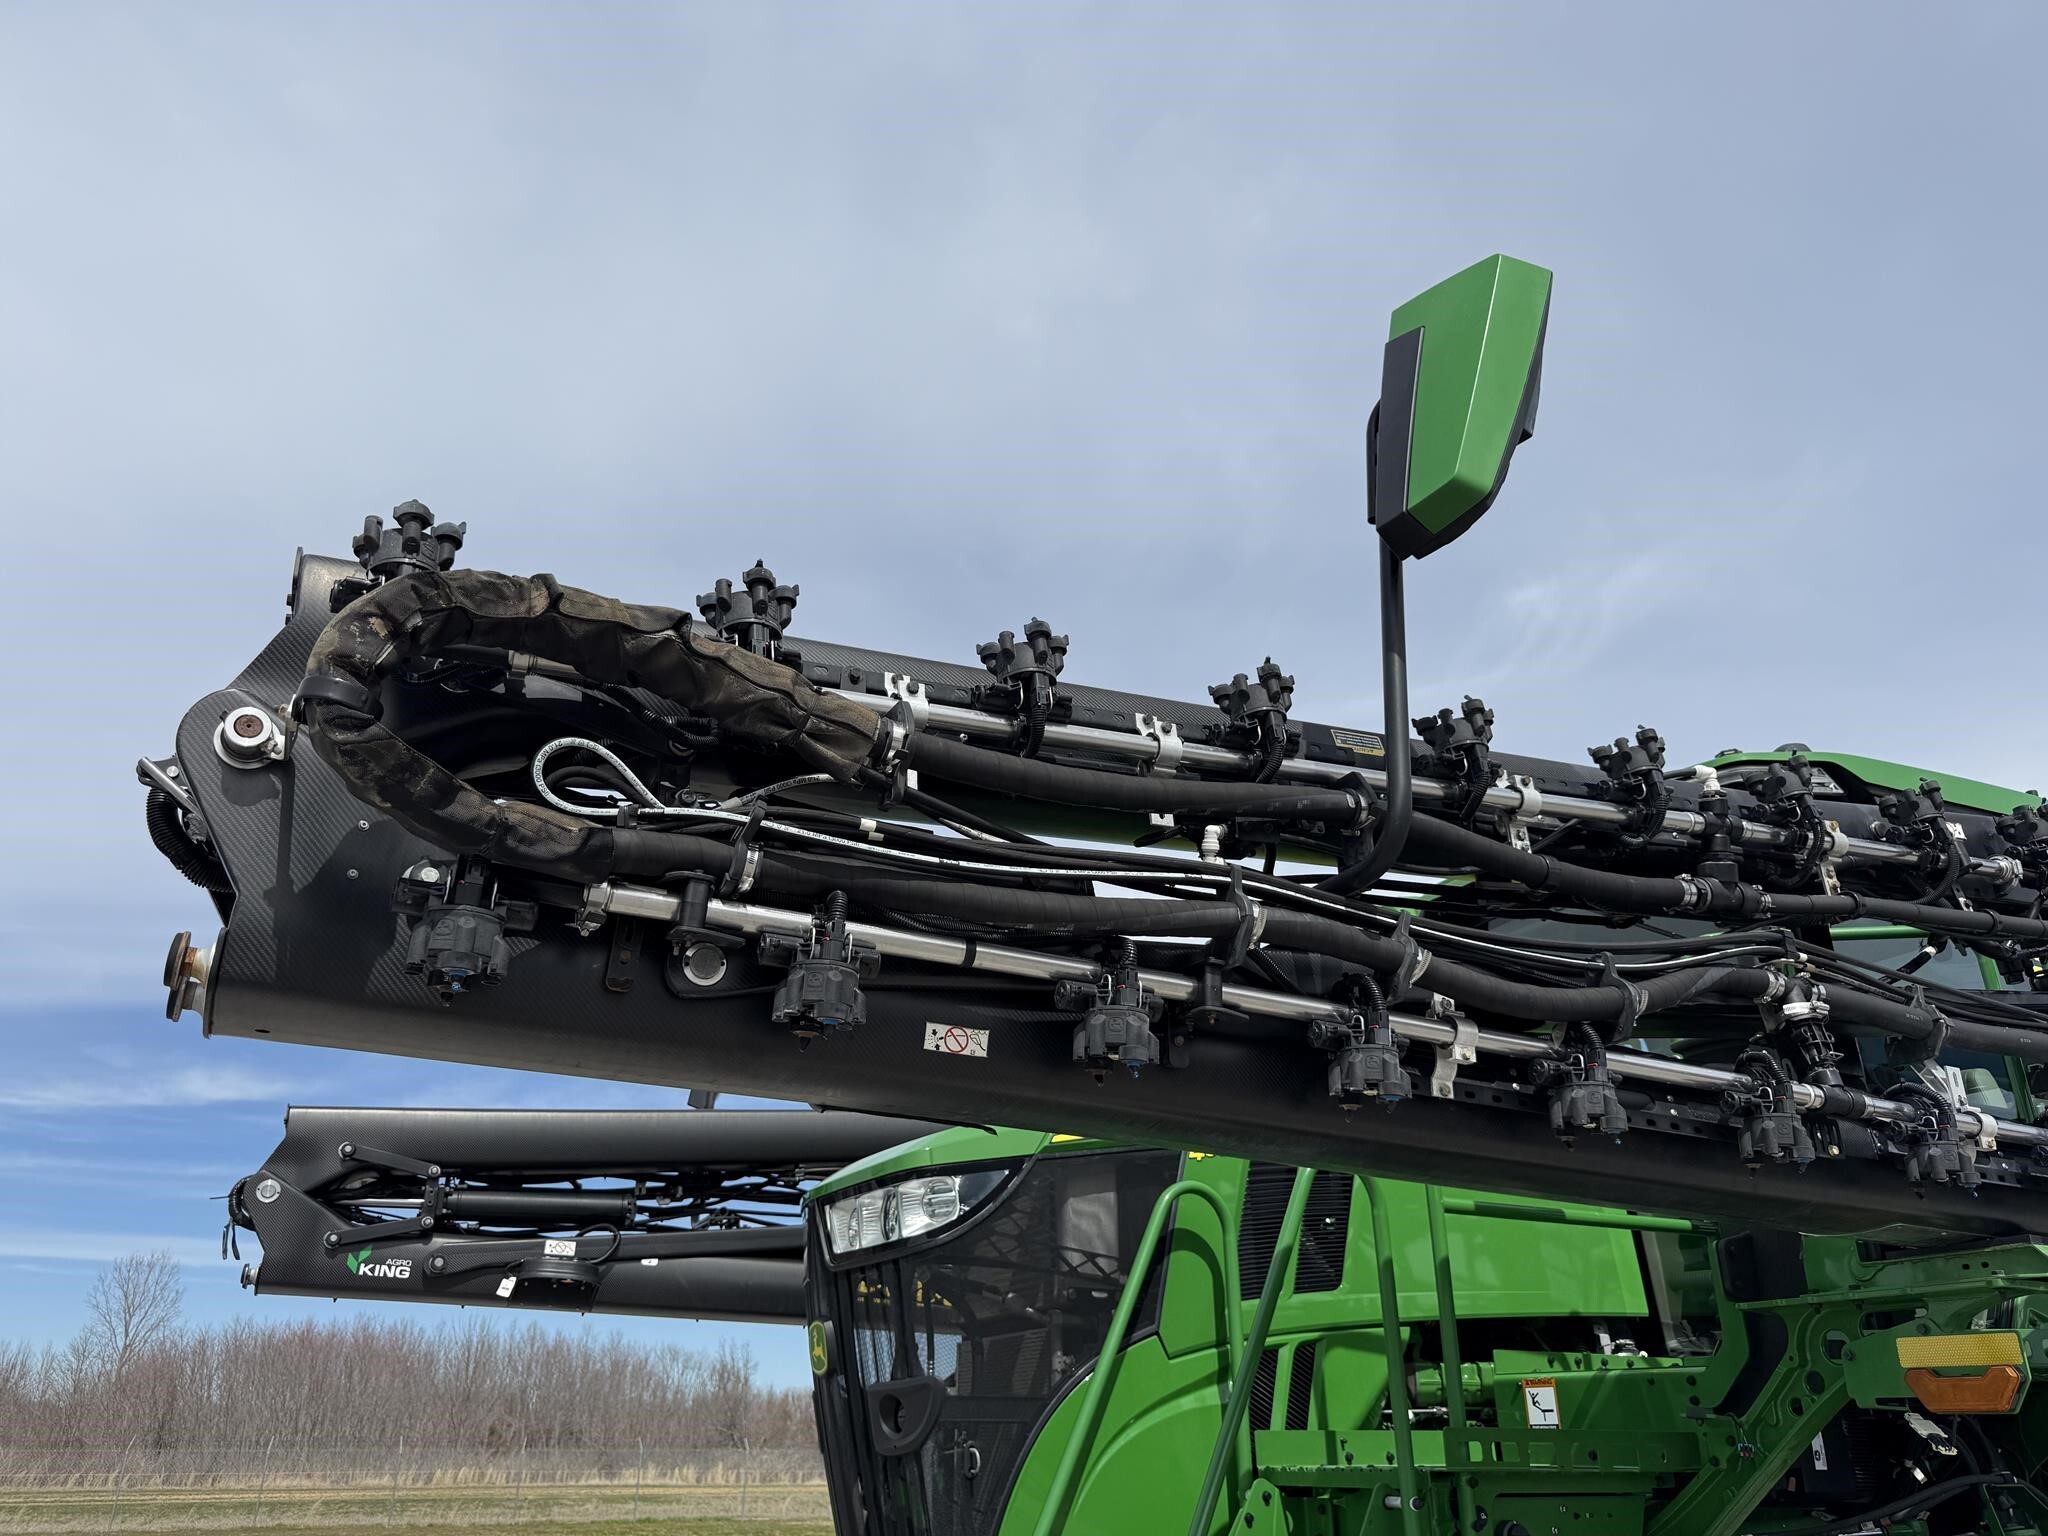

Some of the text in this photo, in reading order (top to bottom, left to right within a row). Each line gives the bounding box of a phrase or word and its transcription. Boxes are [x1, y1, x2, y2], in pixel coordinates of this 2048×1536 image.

[537, 749, 550, 763] MPa
[385, 1258, 412, 1267] AGRO
[358, 1262, 411, 1279] KING
